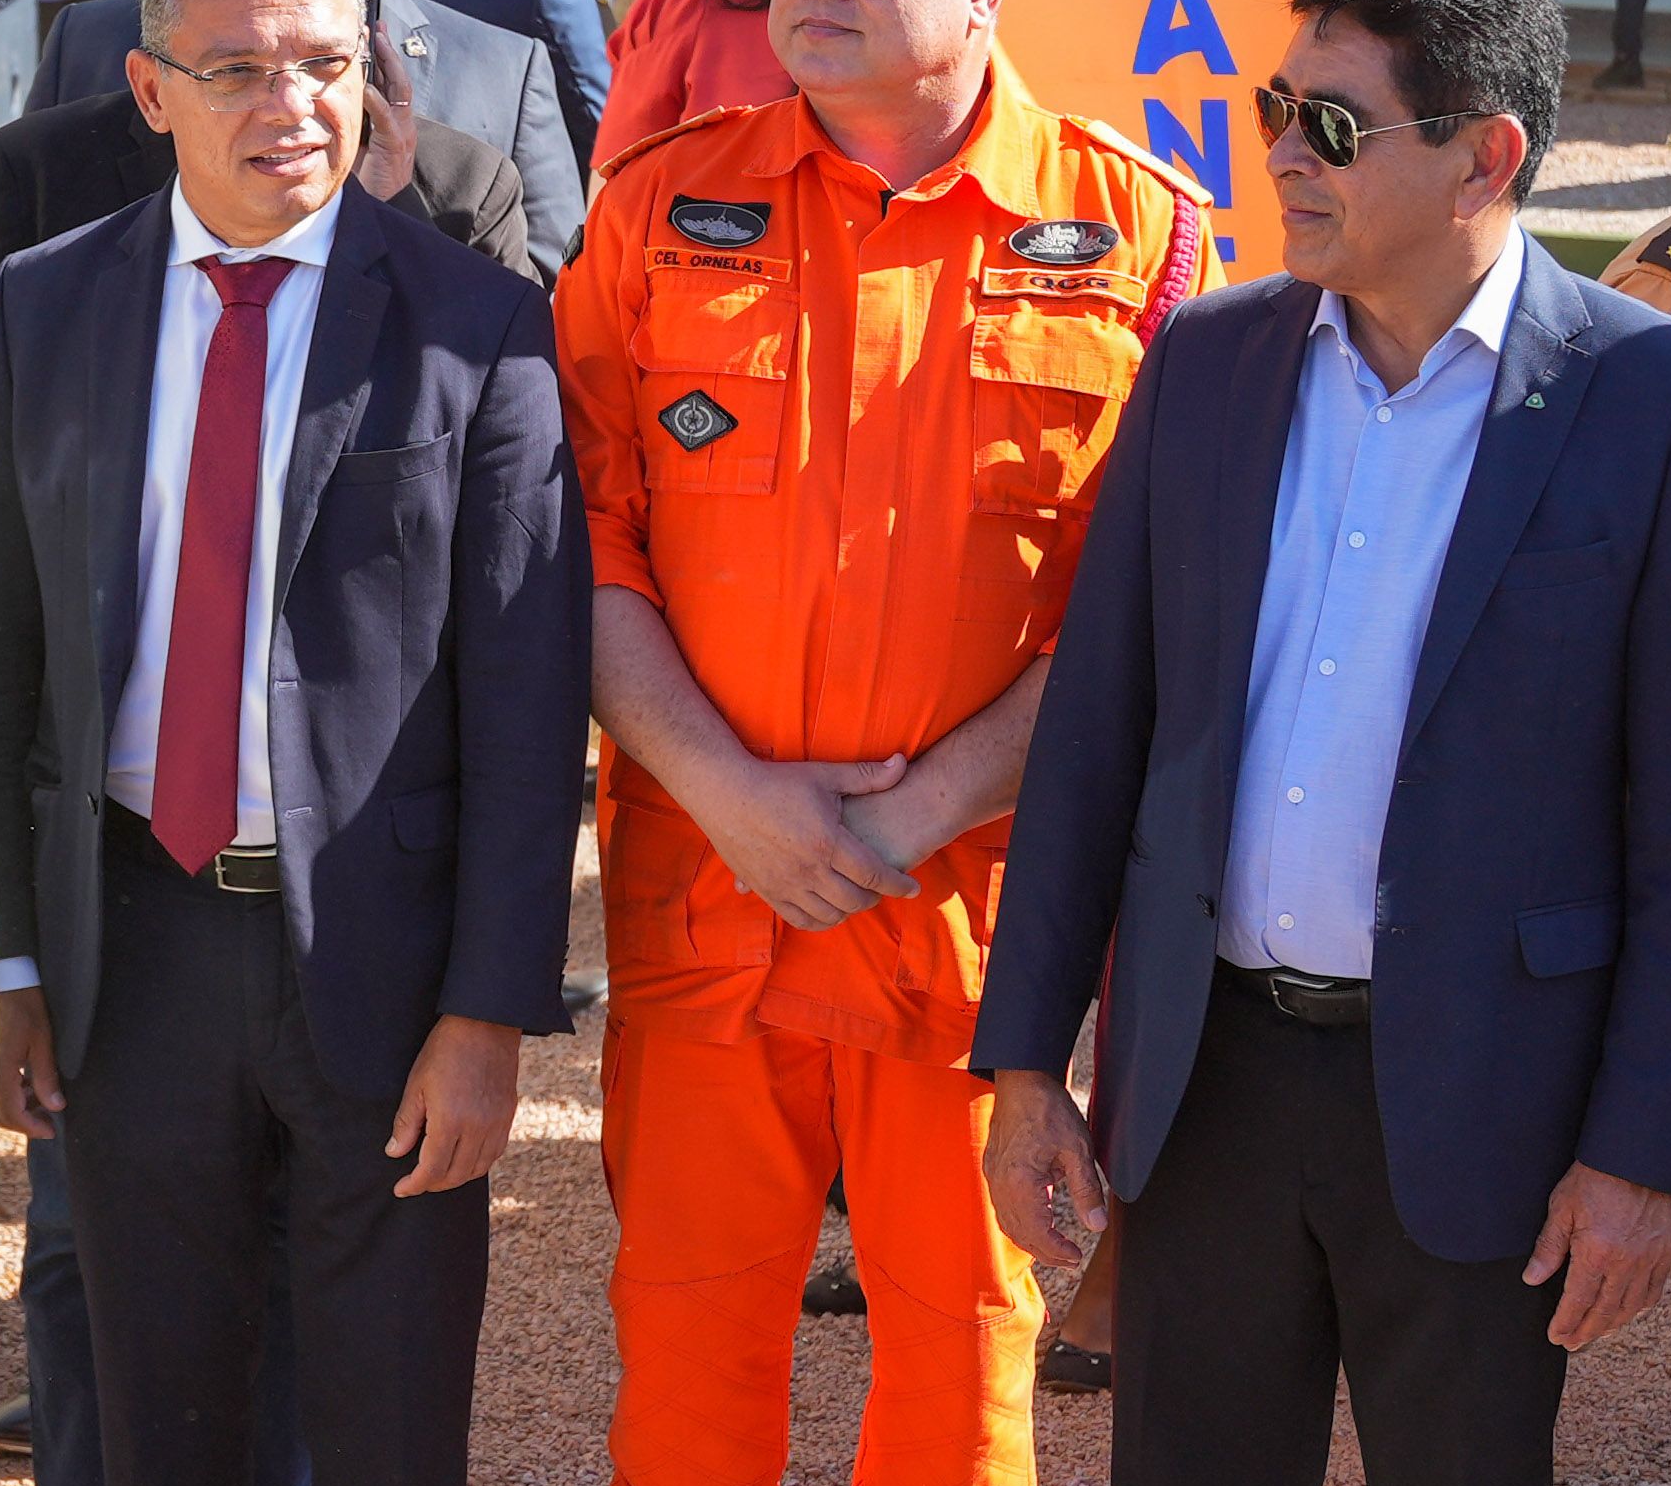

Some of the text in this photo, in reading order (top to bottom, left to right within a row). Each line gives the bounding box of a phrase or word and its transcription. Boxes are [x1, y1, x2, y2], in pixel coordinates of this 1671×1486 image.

[654, 250, 763, 274] CEL ORNELAS
[1029, 276, 1110, 290] QCG
